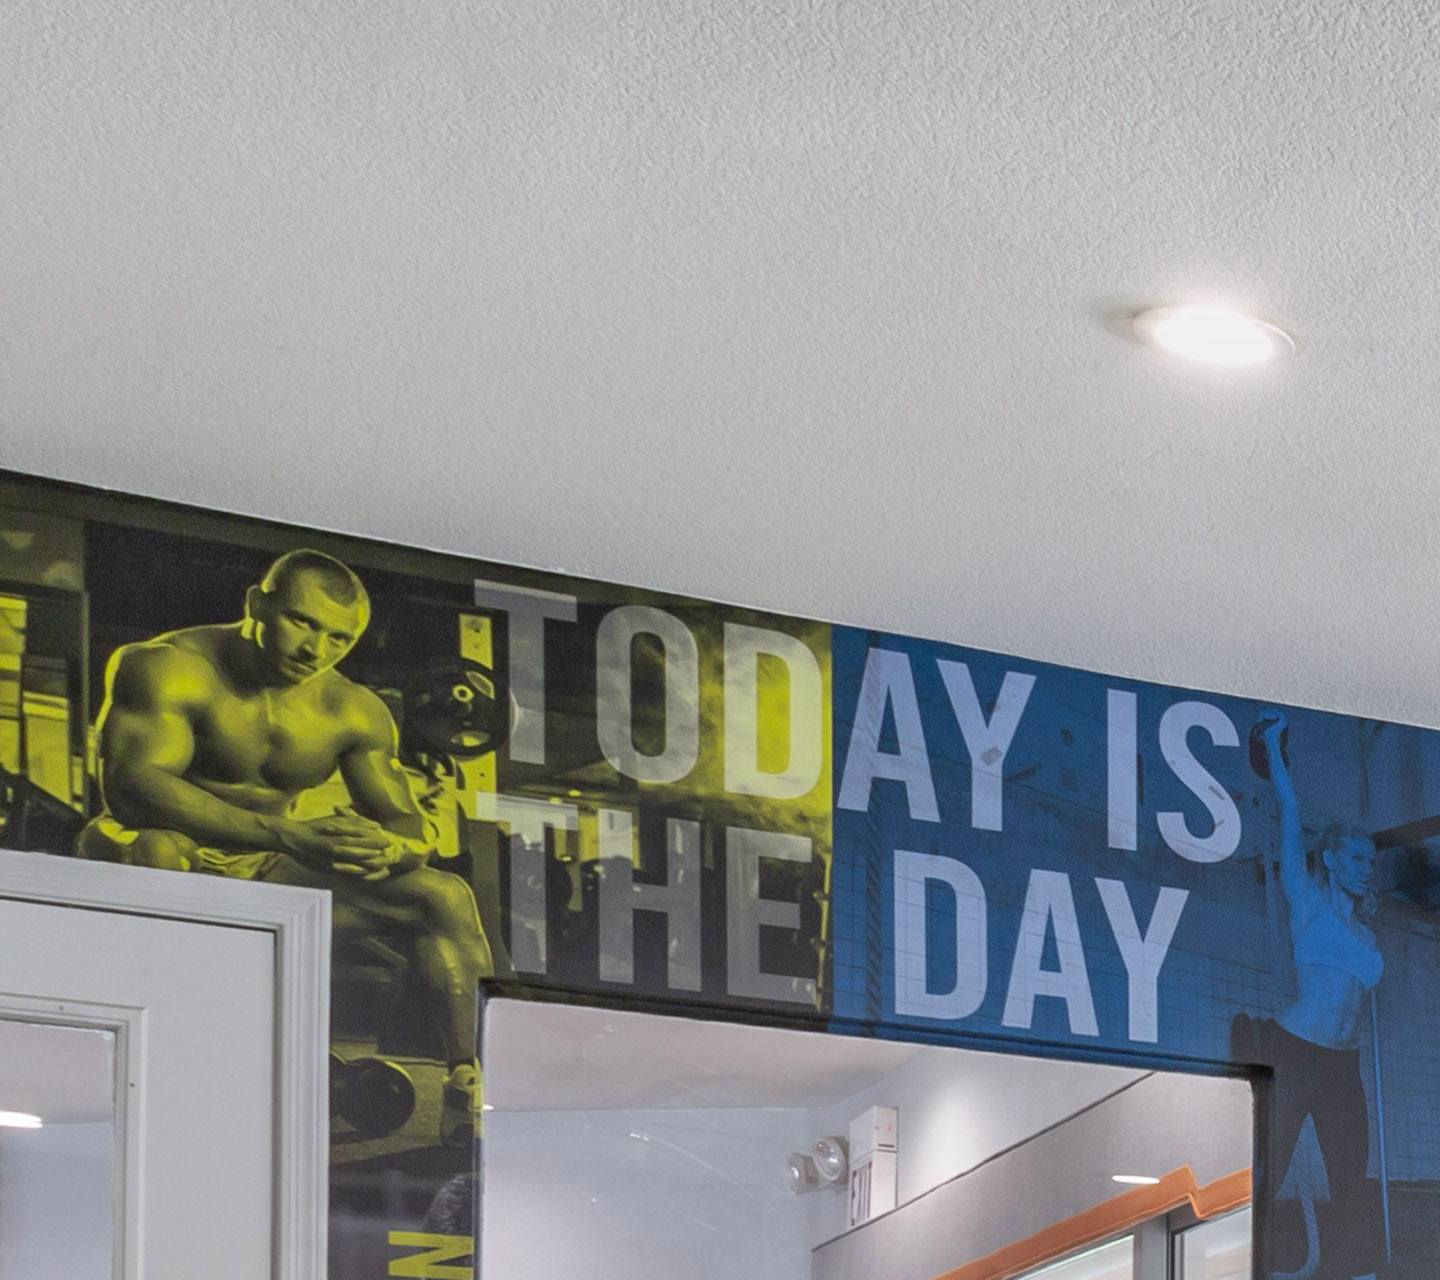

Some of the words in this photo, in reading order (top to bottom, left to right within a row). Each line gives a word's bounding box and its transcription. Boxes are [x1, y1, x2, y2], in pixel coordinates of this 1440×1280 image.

[474, 578, 1037, 833] TODAY
[1107, 688, 1242, 864] IS
[477, 791, 820, 1007] THE
[893, 849, 1194, 1044] DAY
